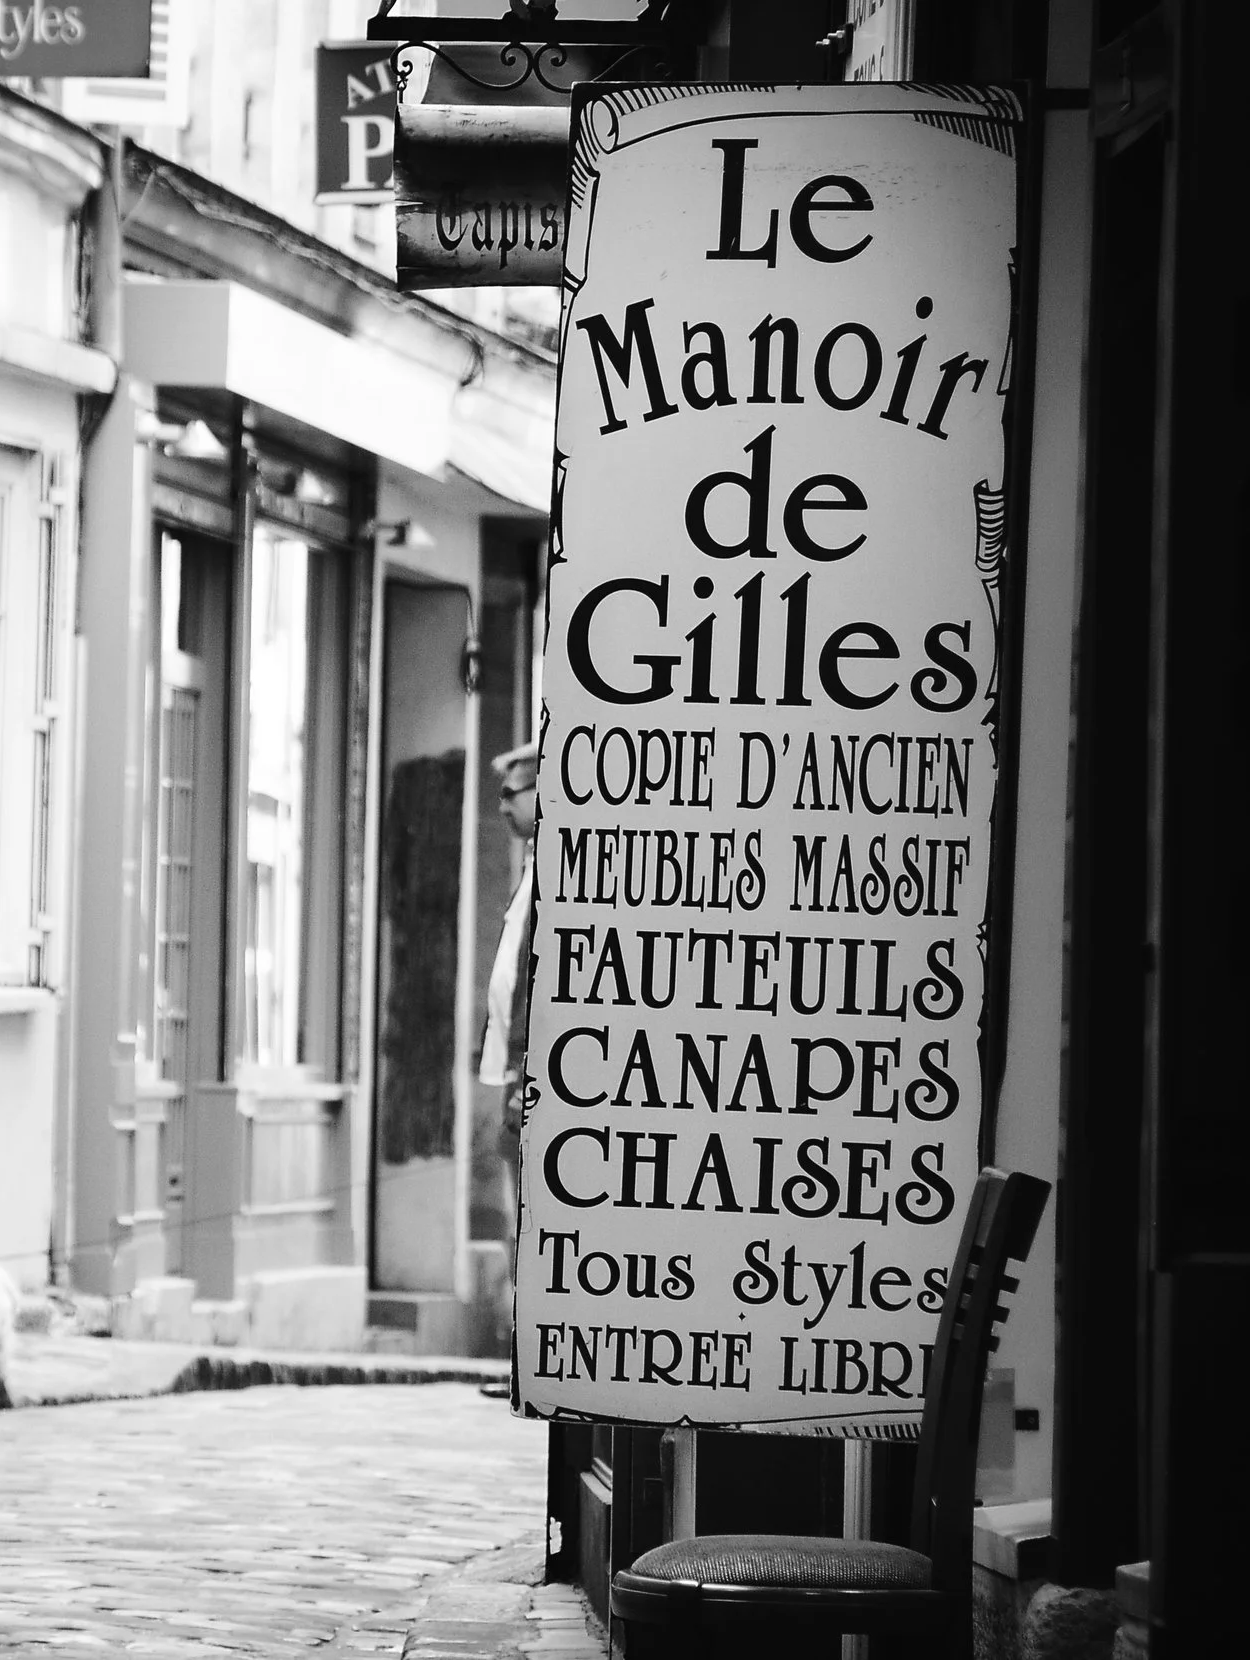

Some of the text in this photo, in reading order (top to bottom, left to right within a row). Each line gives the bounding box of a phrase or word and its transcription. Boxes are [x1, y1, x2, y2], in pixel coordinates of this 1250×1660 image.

[340, 115, 394, 190] P
[705, 138, 875, 269] Le
[576, 296, 989, 440] Manoir
[684, 424, 868, 562] de
[566, 570, 978, 713] Gilles
[560, 724, 974, 819] COPIE D'ANCIEN
[555, 825, 971, 918] MEUBLES MASSIF
[551, 924, 965, 1023] FAUTEUILS
[548, 1026, 959, 1123] CANAPES
[543, 1126, 955, 1226] CHAISES
[539, 1228, 949, 1329] Tous Styles
[534, 1322, 752, 1391] ENTREE
